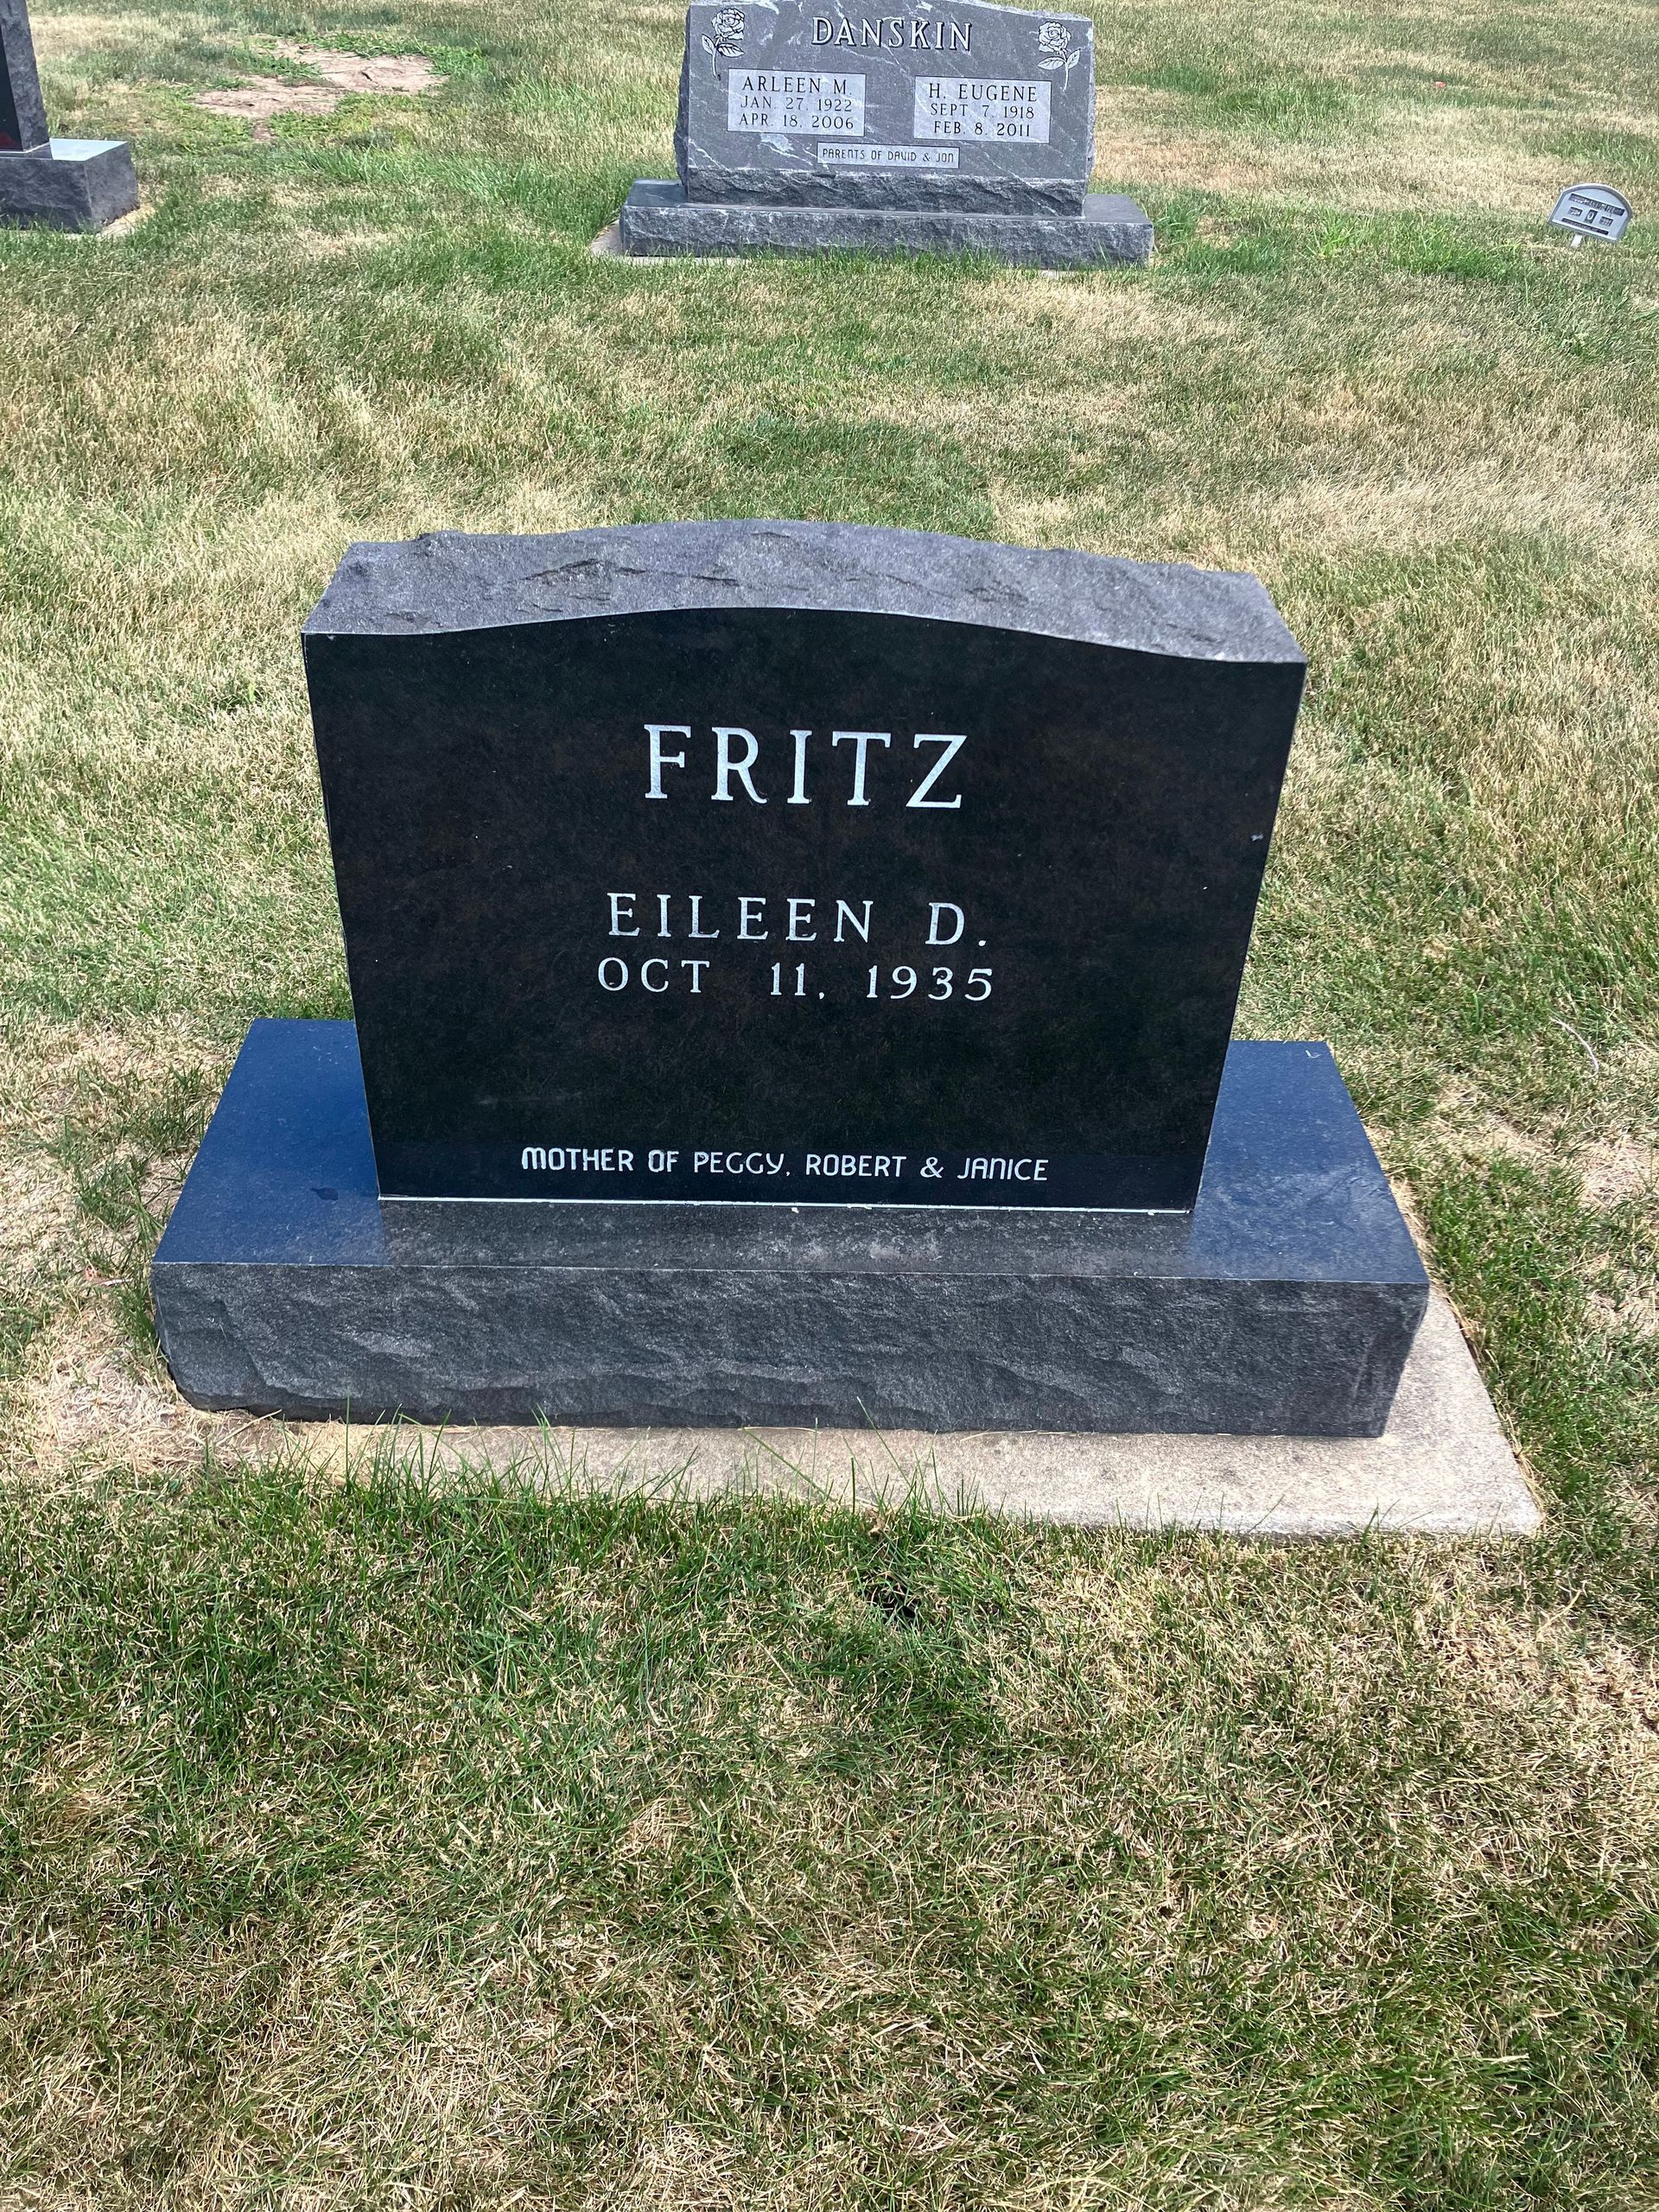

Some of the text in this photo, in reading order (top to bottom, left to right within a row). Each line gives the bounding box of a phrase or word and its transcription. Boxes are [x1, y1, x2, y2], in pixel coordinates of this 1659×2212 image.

[811, 16, 972, 51] DANSKIN
[742, 76, 853, 95] ARLEEN M.
[929, 83, 1037, 102] H. EUGENE
[741, 96, 777, 110] JAN.
[817, 99, 852, 112] 1922
[930, 103, 972, 118] SEPT.
[1003, 105, 1034, 119] 1918
[739, 113, 774, 126] APR.
[811, 116, 854, 130] 2006
[934, 121, 966, 135] FEB.
[996, 123, 1030, 137] 2011
[823, 148, 954, 162] PARENTS OF DAVID & JON
[644, 723, 968, 809] FRITZ
[607, 892, 988, 948] EILEEN D.
[597, 957, 994, 1002] OCT 11, 1935
[521, 1146, 1050, 1182] MOTHER OF PEGGY, ROBERT & JANICE
